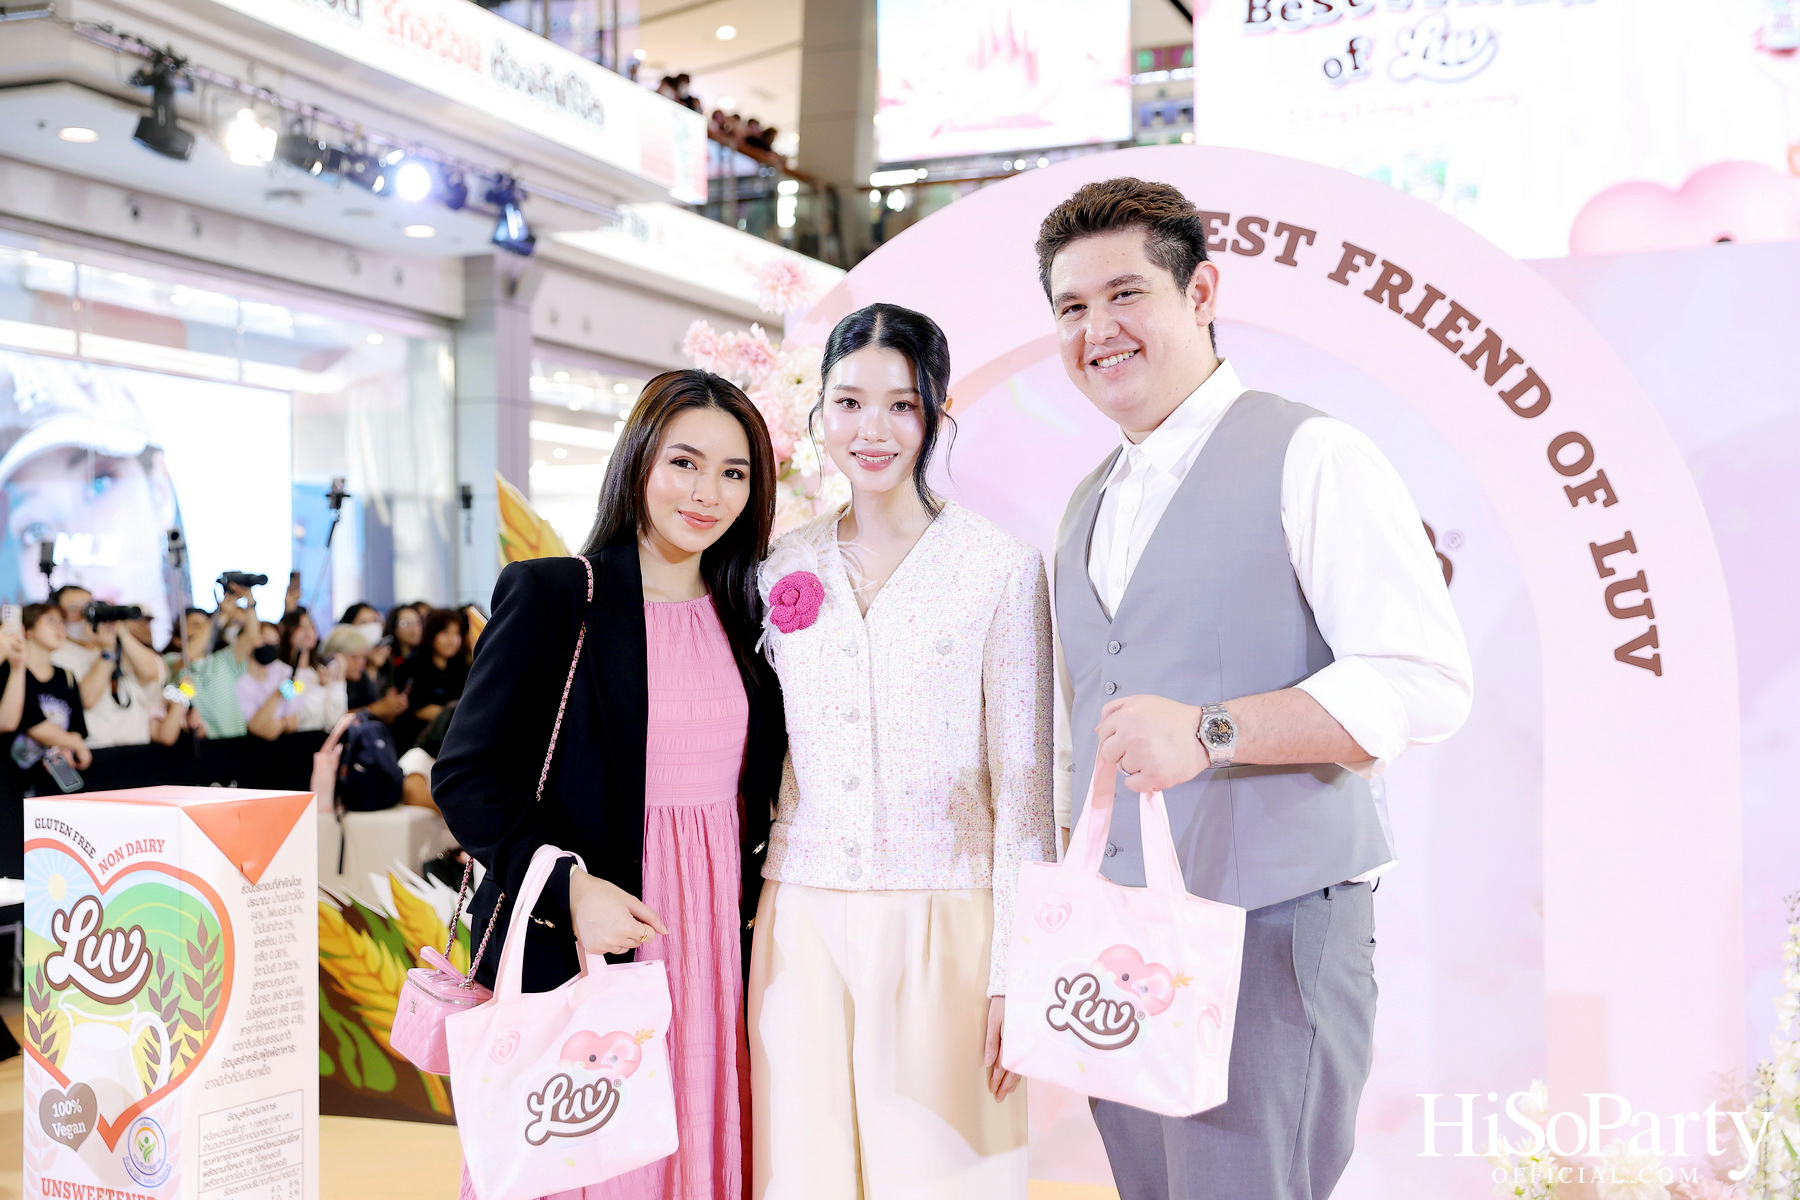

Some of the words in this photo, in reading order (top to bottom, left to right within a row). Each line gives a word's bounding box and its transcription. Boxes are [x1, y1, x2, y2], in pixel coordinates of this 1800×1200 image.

[1322, 36, 1366, 80] of
[1388, 11, 1500, 84] Luv
[1197, 210, 1317, 268] EST
[1327, 241, 1552, 419] FRIEND
[1547, 431, 1619, 508] OF
[1589, 530, 1663, 677] LUV
[34, 818, 73, 838] GLUTEN
[72, 830, 97, 859] FREE
[98, 846, 124, 875] NON
[125, 838, 166, 858] DAIRY
[44, 895, 153, 1005] Luv
[1045, 972, 1140, 1050] Luv
[51, 1098, 83, 1118] 100%
[51, 1121, 88, 1140] Vegan
[524, 1072, 620, 1146] Luv
[41, 1177, 156, 1200] UNSWEET
